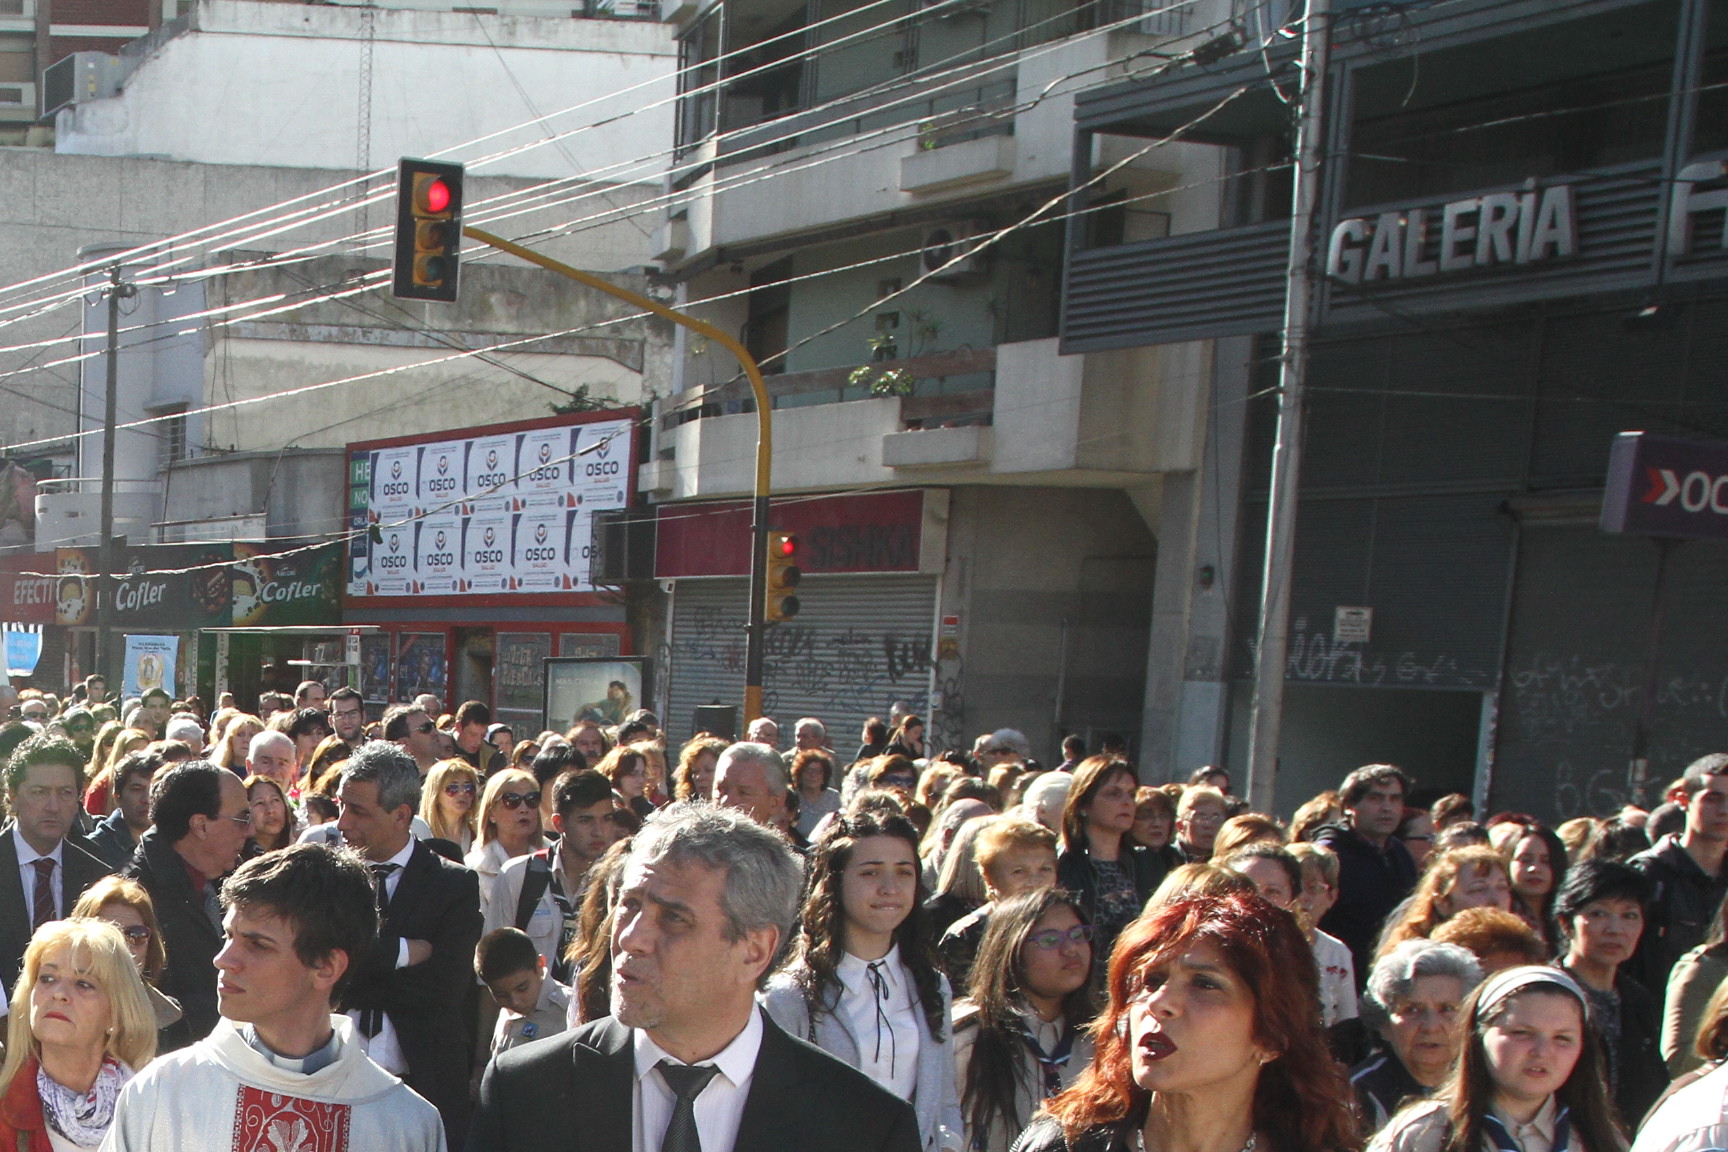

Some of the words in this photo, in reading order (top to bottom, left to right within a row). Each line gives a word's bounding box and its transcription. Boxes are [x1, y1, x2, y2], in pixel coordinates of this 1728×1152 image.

[1327, 177, 1575, 284] GALERÍA
[529, 467, 560, 482] OSCO
[585, 461, 619, 477] OSCO
[429, 477, 456, 492] OSCO
[477, 473, 506, 488] OSCO
[383, 481, 409, 496] OSCO
[1680, 470, 1728, 513] OC
[354, 490, 368, 504] NO
[381, 555, 407, 568] OSCO
[426, 553, 453, 566] OSCO
[474, 550, 503, 564] OSCO
[525, 547, 556, 561] OSCO
[14, 578, 53, 605] EFECTI
[115, 580, 167, 612] Cofler
[260, 580, 321, 603] Cofler
